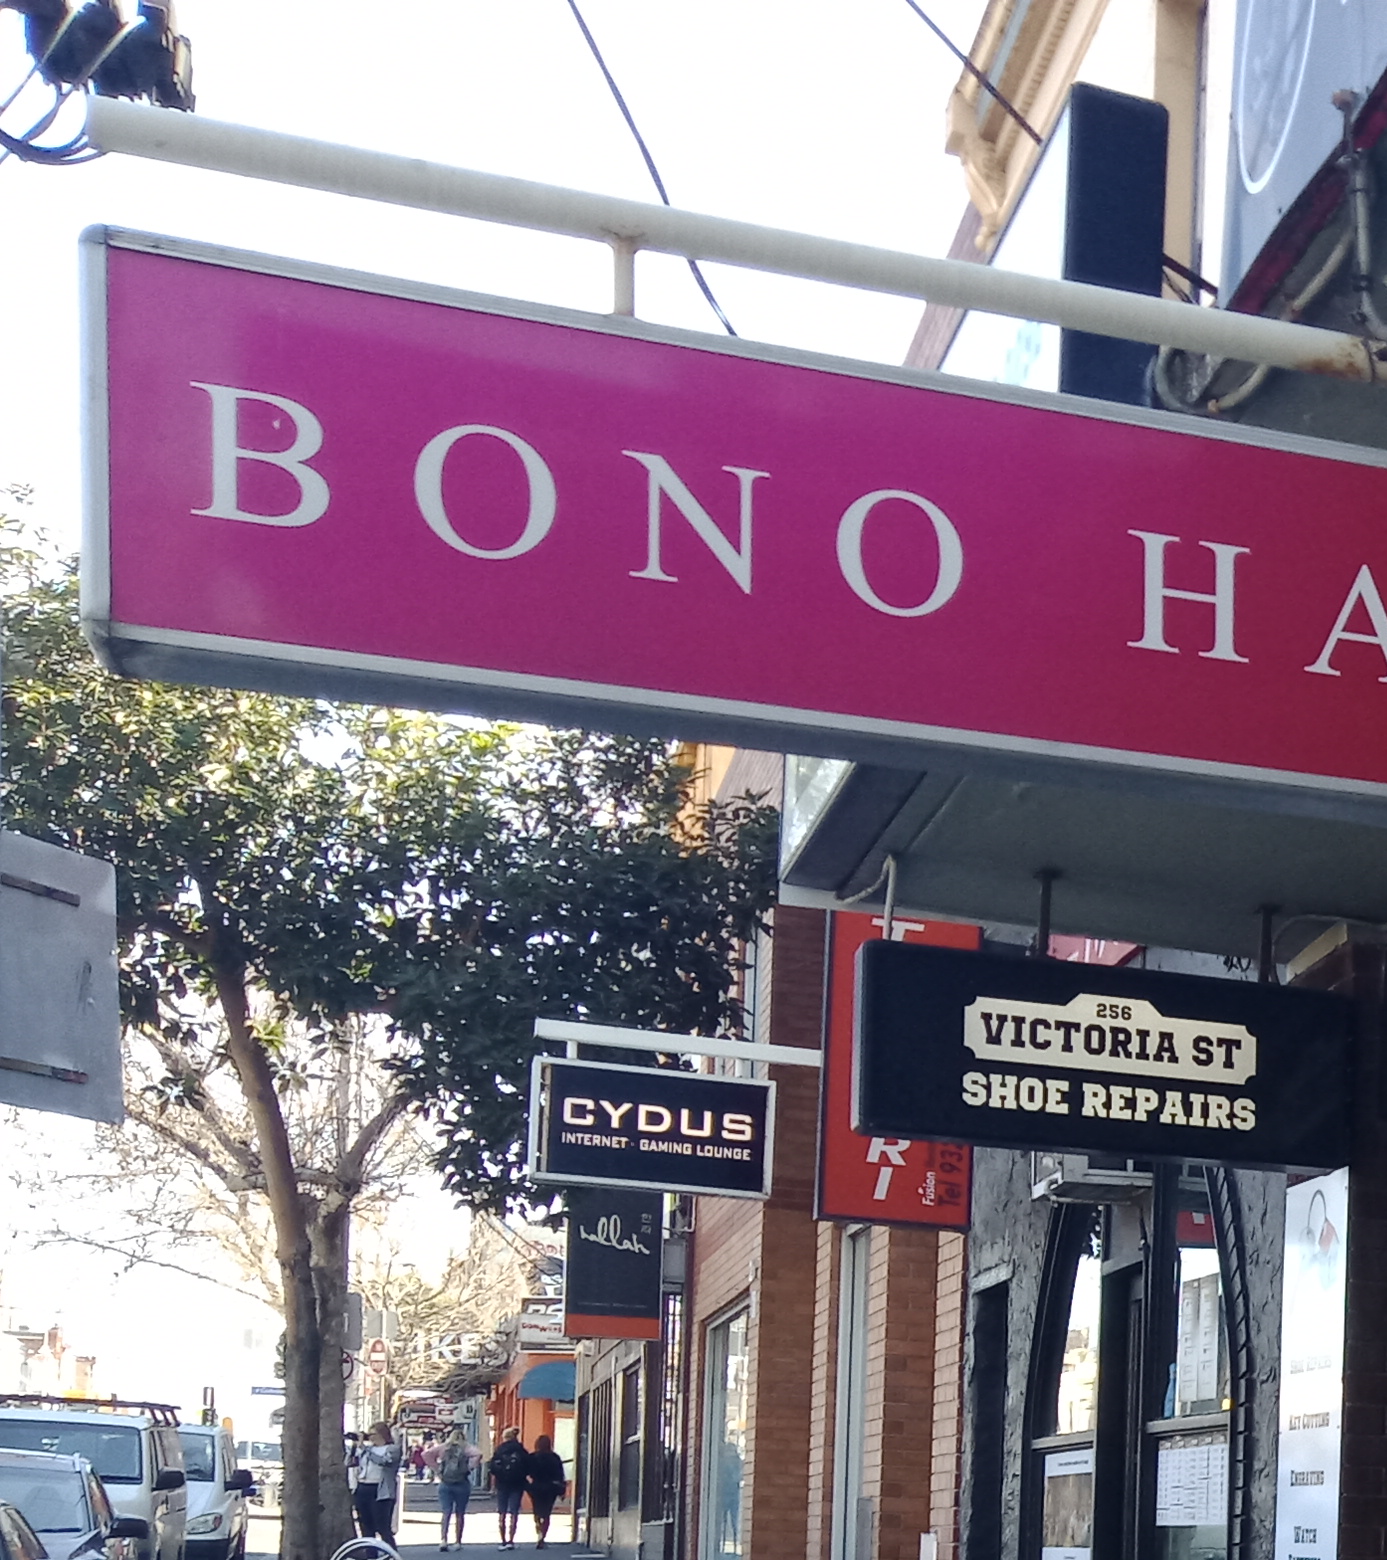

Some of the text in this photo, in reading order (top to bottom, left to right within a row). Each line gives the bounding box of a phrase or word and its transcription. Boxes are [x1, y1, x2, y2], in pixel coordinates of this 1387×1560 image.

[190, 381, 964, 618] BONO
[1096, 1003, 1132, 1021] 256
[980, 1012, 1242, 1069] VICTORIA ST
[562, 1096, 754, 1142] CYDUS
[962, 1071, 1256, 1131] SHOE REPAIRS
[561, 1131, 751, 1161] INTERNET GAMING LOUNGE
[917, 1171, 936, 1206] Fusion
